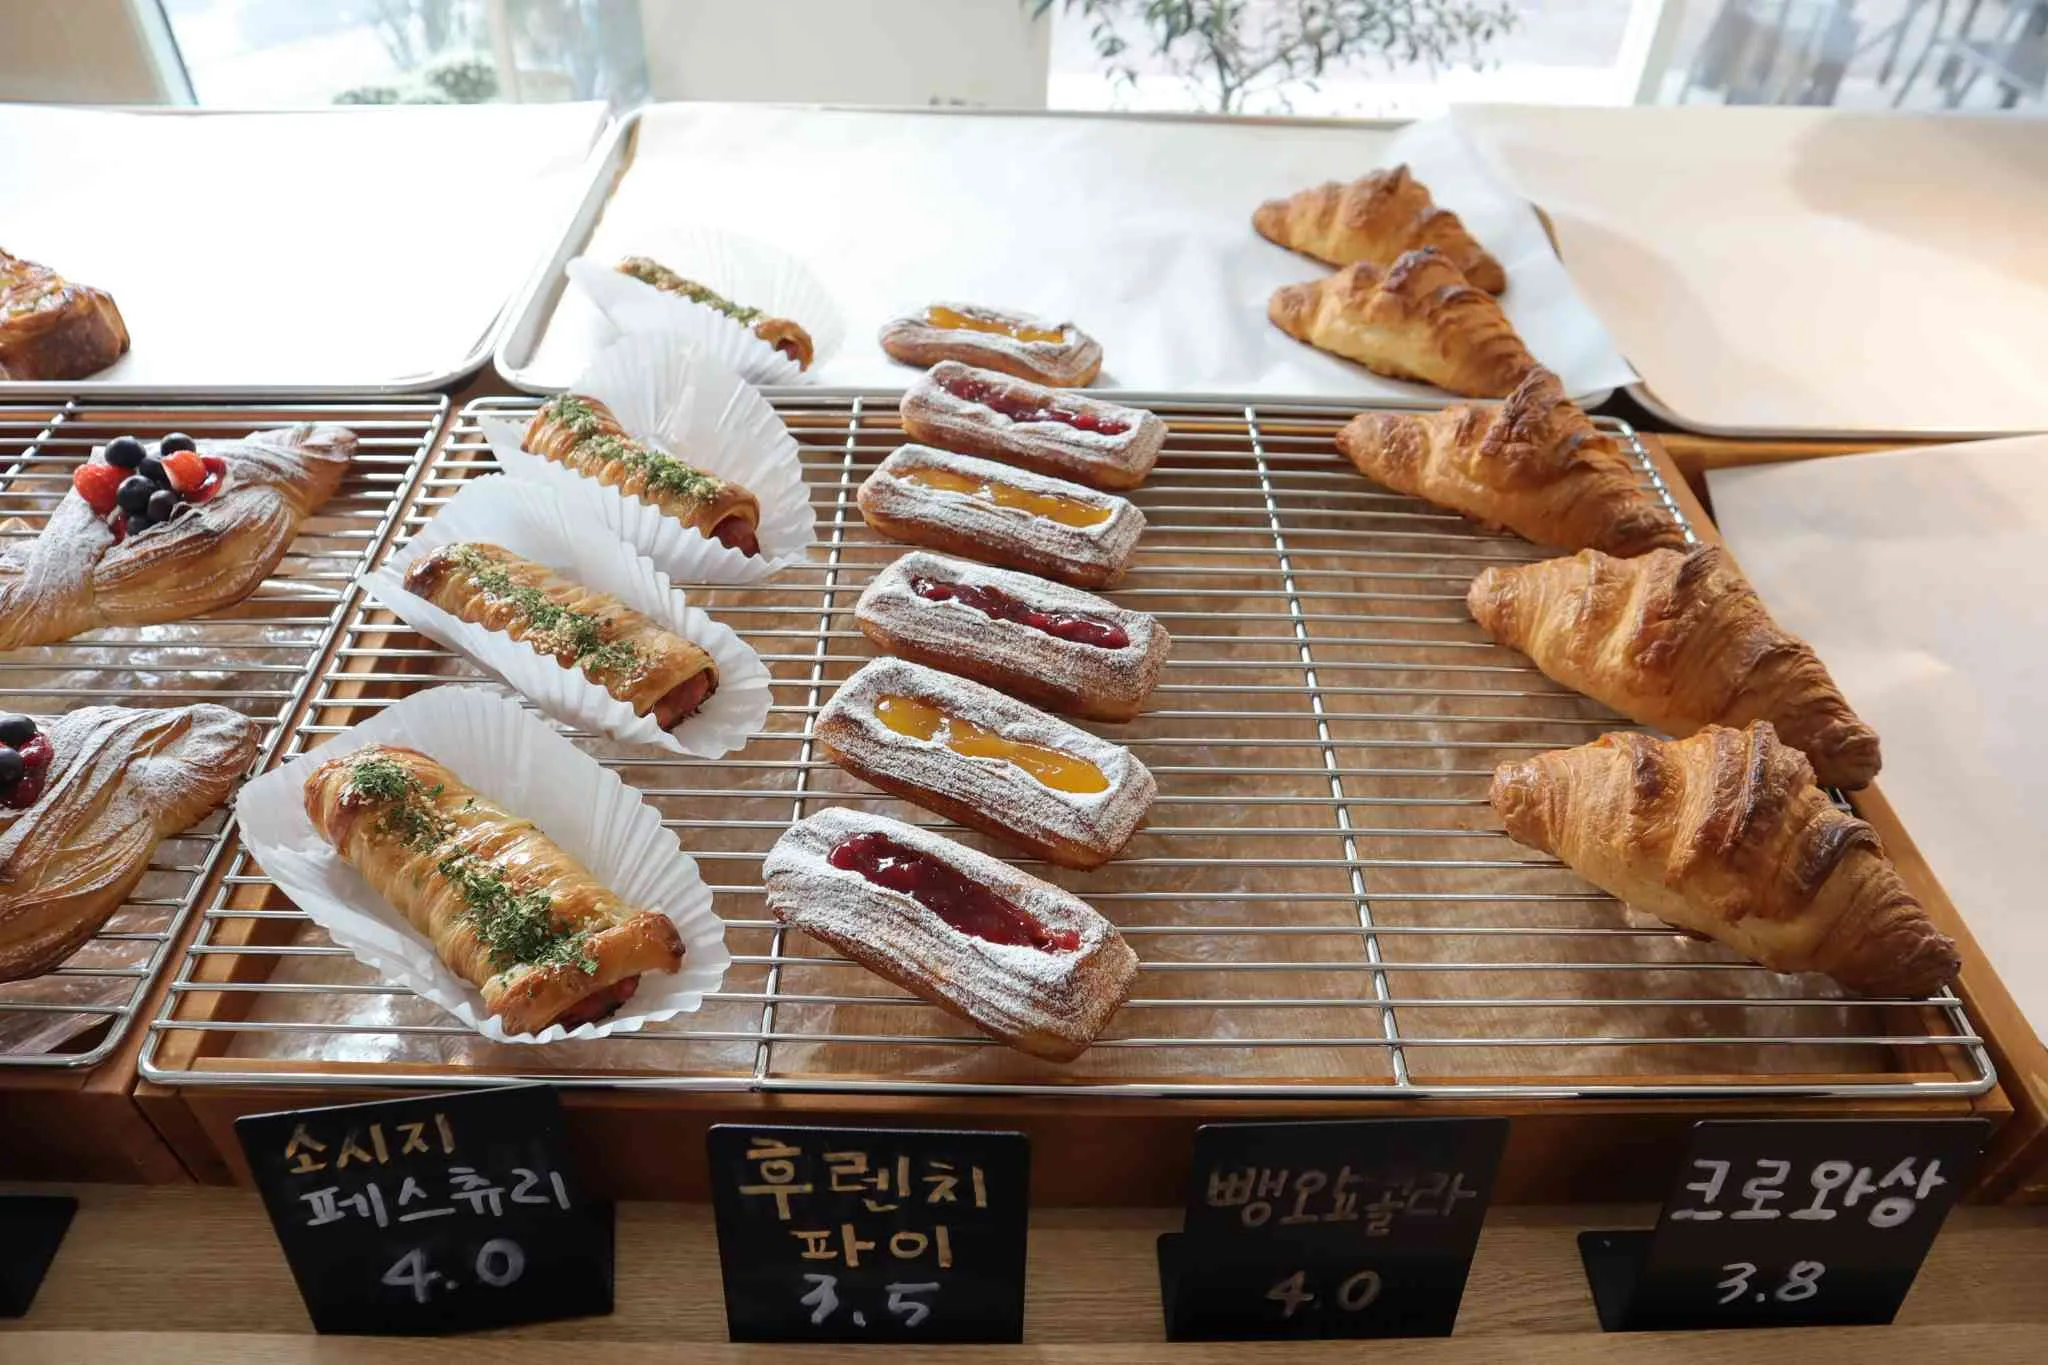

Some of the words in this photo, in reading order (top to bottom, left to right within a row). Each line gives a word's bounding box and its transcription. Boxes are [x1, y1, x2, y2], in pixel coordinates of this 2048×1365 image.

[285, 1112, 456, 1175] 소시지
[299, 1166, 571, 1229] 페스츄리
[738, 1137, 988, 1221] 후렌치
[1670, 1156, 1948, 1228] 크로와상
[382, 1238, 526, 1304] 4.0
[790, 1222, 953, 1269] 파이
[800, 1273, 941, 1327] 3.5
[1264, 1269, 1383, 1319] 4.0
[1717, 1259, 1826, 1305] 3.8
